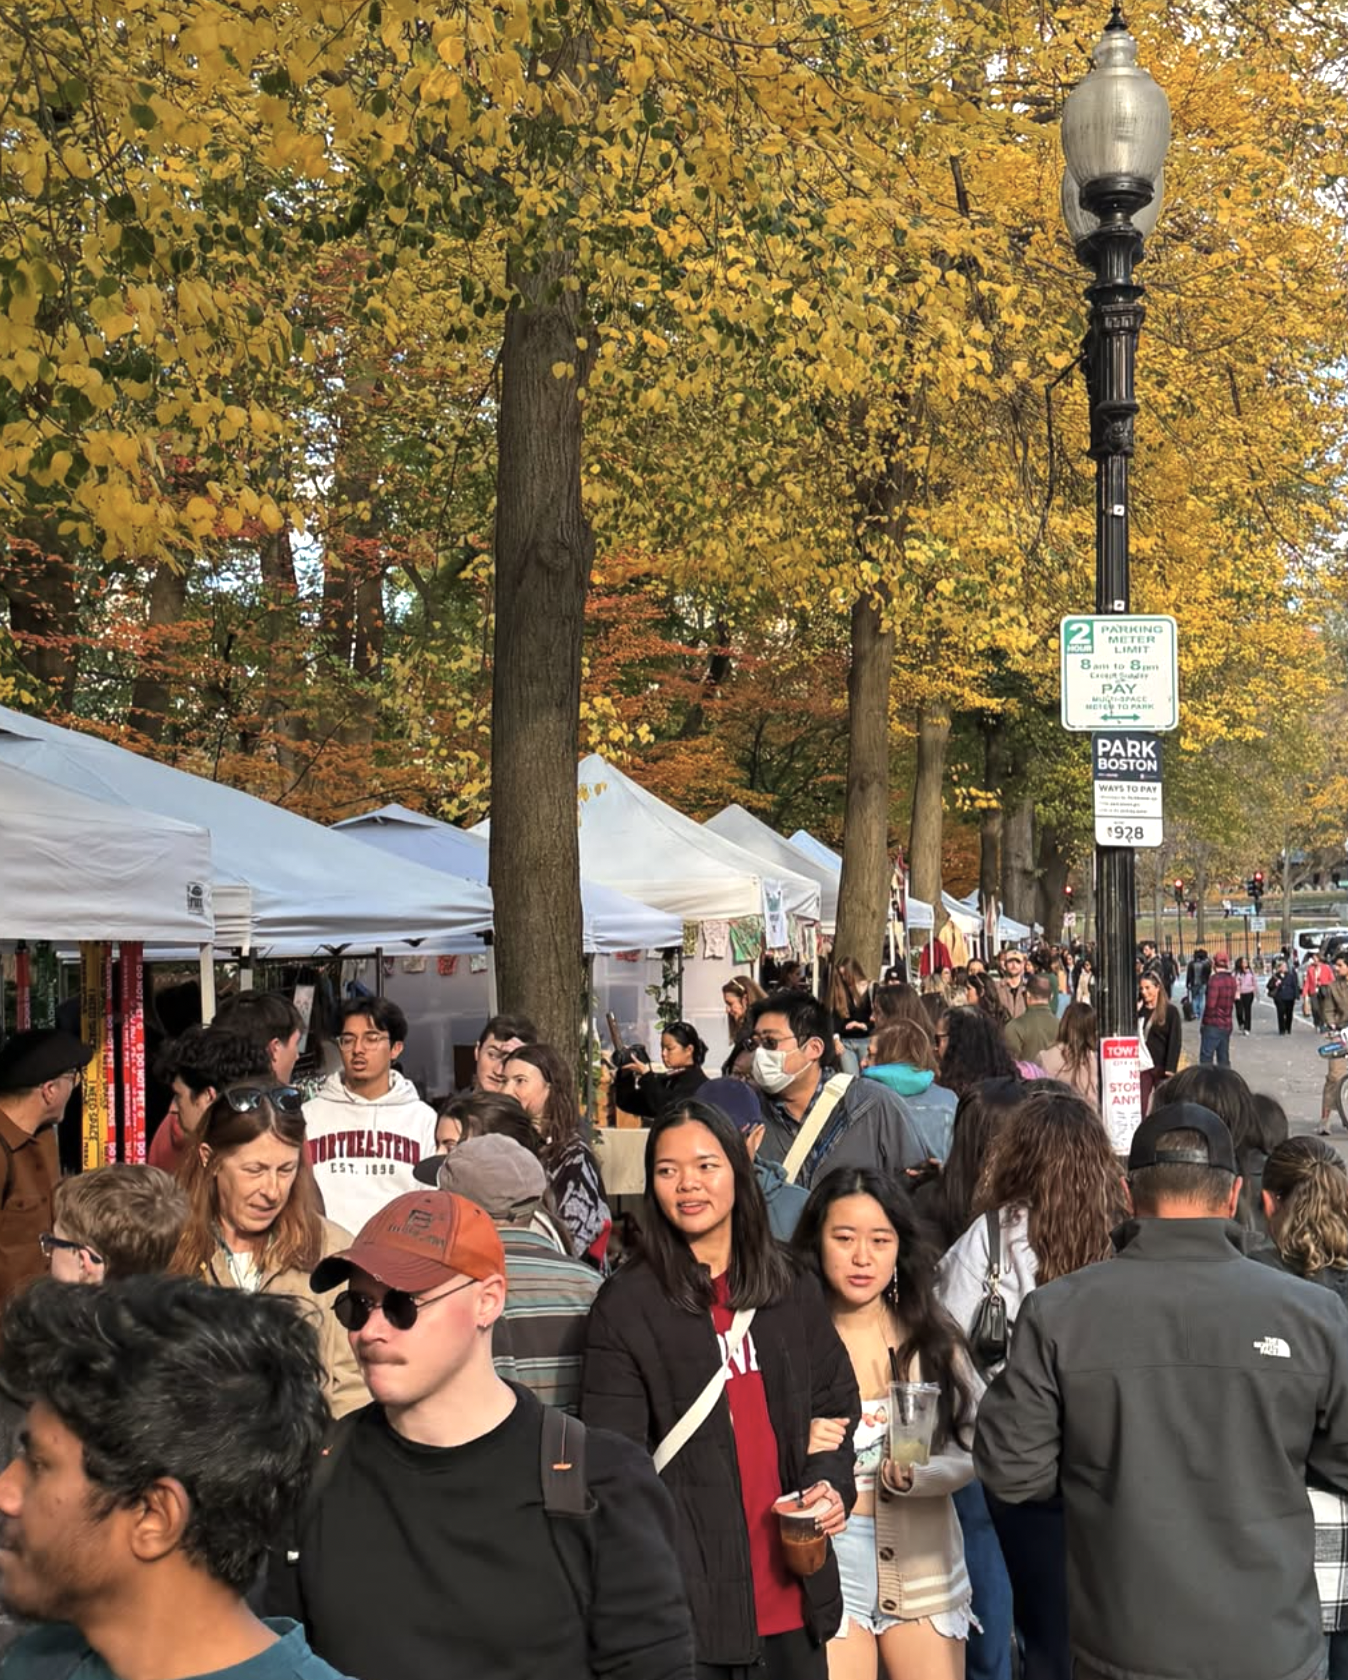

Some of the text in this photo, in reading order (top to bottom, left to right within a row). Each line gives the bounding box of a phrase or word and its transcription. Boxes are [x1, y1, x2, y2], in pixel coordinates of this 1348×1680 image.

[1069, 623, 1090, 644] 2
[1101, 626, 1163, 634] PARKING
[1115, 646, 1150, 654] LIMIT
[1101, 683, 1137, 694] PAY
[1097, 739, 1156, 758] PARK
[1098, 758, 1157, 772] BOSTON
[1099, 784, 1124, 792] WAYS
[1140, 785, 1157, 793] PAY
[308, 1130, 420, 1165] NORTHEASTERN
